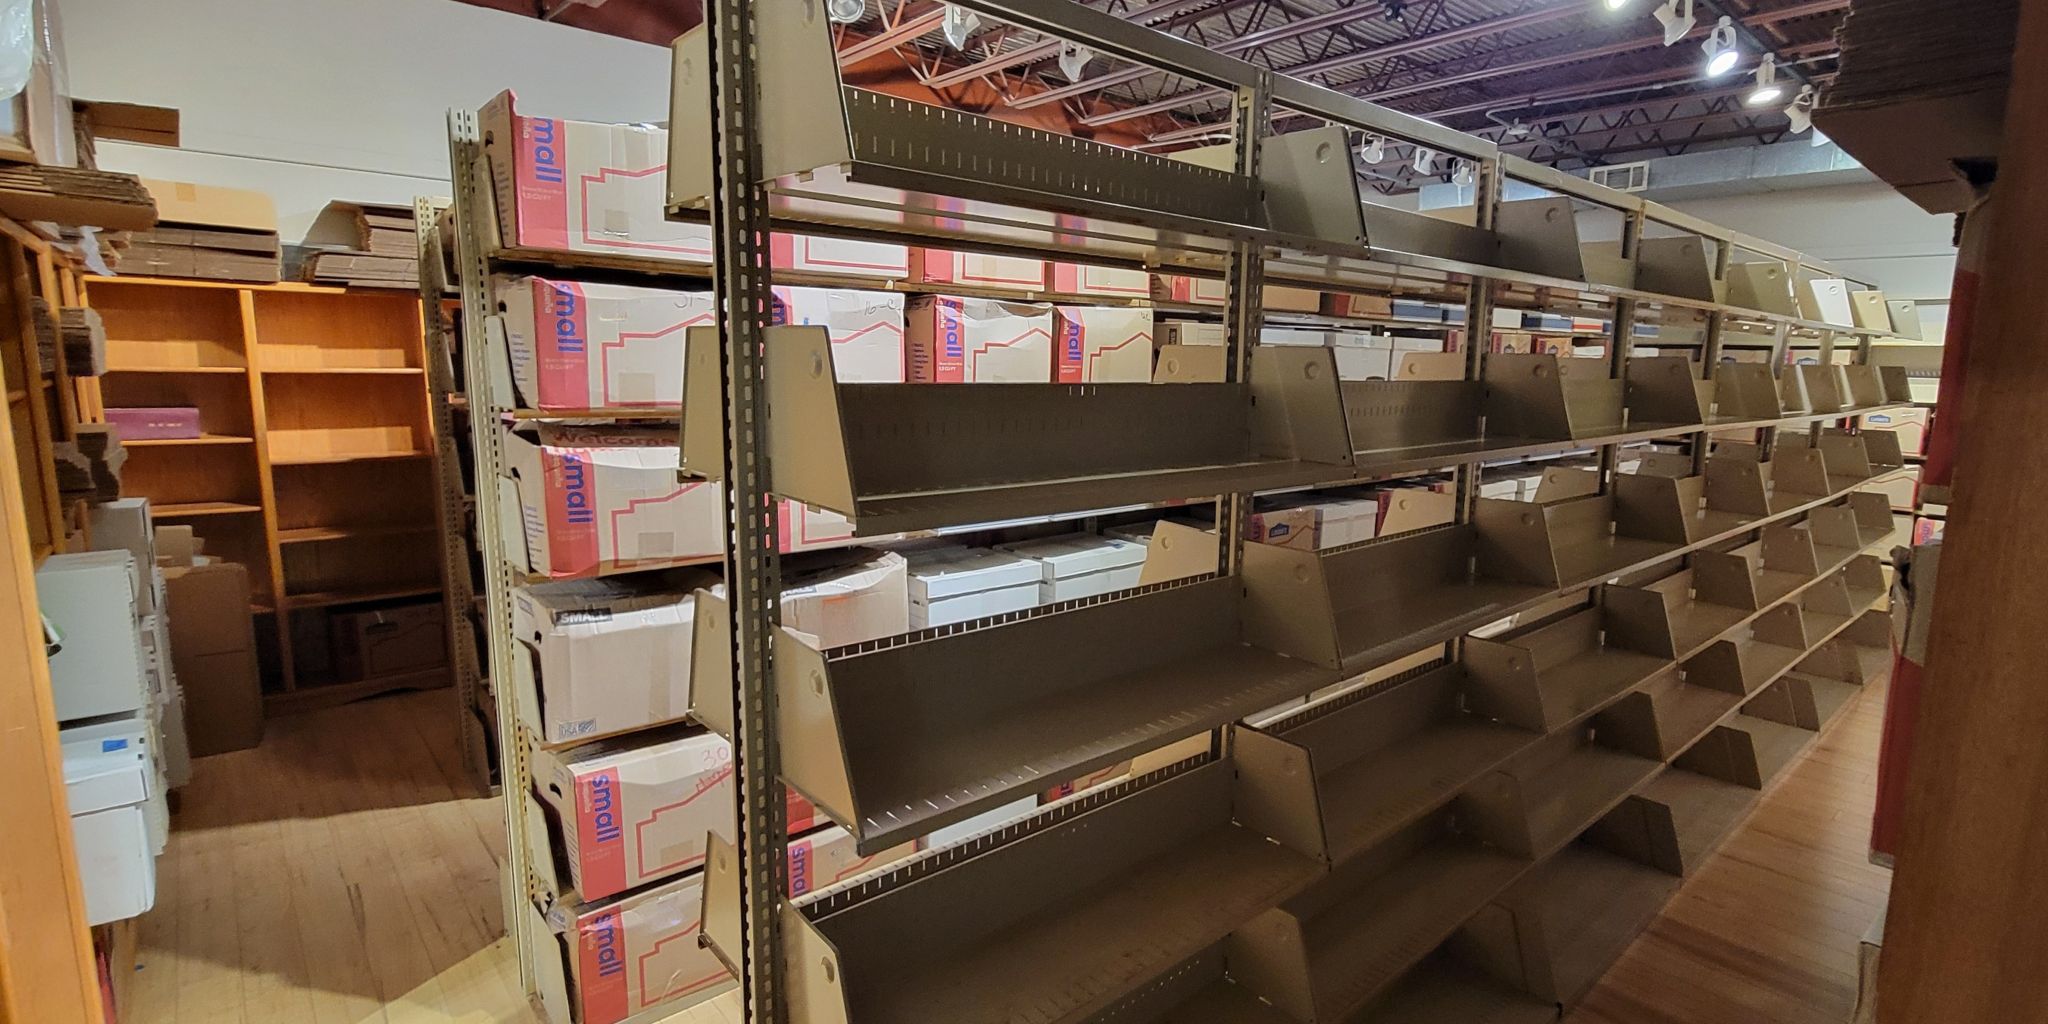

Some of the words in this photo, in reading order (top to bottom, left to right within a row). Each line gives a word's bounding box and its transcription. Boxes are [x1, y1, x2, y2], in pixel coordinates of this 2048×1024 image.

[552, 430, 675, 446] Welcome
[563, 453, 593, 524] small
[592, 774, 620, 843] small
[793, 847, 805, 898] sma
